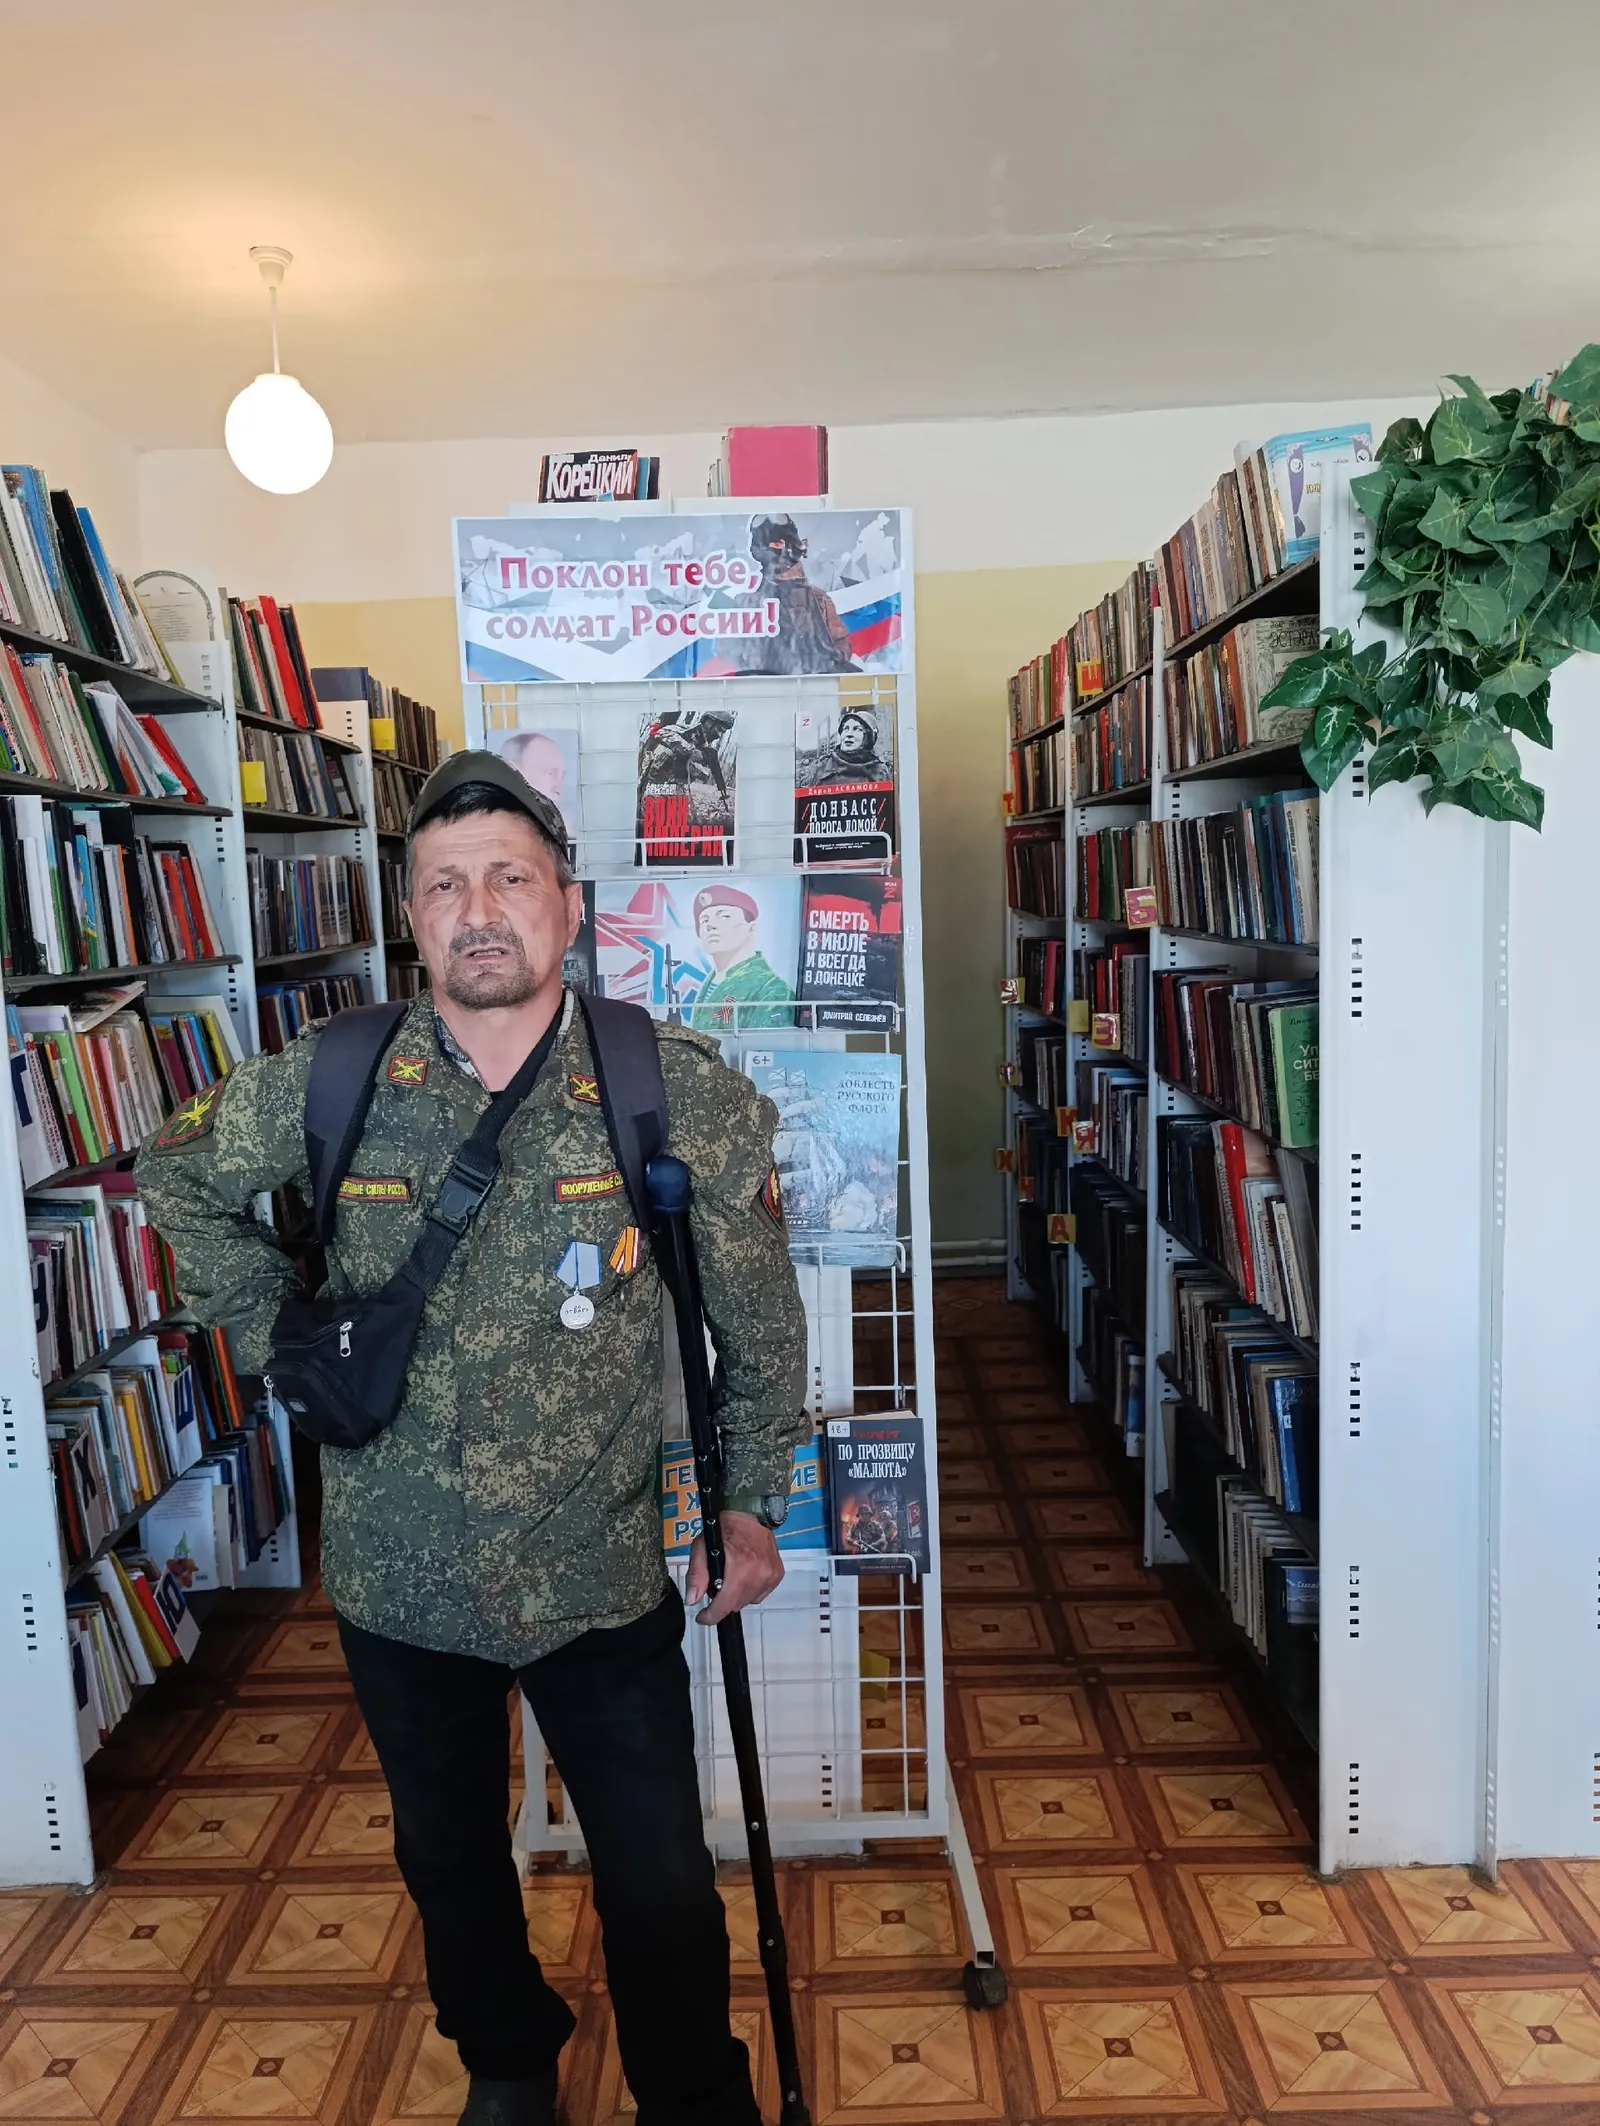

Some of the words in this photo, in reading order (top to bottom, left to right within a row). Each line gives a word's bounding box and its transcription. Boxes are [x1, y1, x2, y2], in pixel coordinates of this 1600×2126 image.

[500, 557, 648, 589] Поклон
[663, 554, 758, 590] тебе,
[486, 613, 615, 643] солдат
[631, 601, 777, 637] России!
[809, 798, 877, 823] ДОНБАСС
[809, 909, 870, 932] СМЕРТЬ
[807, 931, 819, 950] В
[821, 932, 868, 953] ИЮЛЕ
[805, 951, 816, 968] И
[818, 953, 867, 971] ВСЕГДА
[805, 969, 813, 984] В
[814, 971, 867, 987] ДОНЕЦКЕ
[752, 1055, 770, 1065] 6+
[836, 1079, 895, 1090] ДОБЛЕСТЬ
[837, 1091, 895, 1100] РУССКОГО
[848, 1103, 888, 1114] ФЛОТА
[1050, 1216, 1070, 1240] А
[830, 1425, 848, 1434] 18+
[837, 1444, 853, 1461] ПО
[857, 1442, 916, 1463] ПРОЗВИЩУ
[848, 1461, 908, 1479] «МАЛЮТА»
